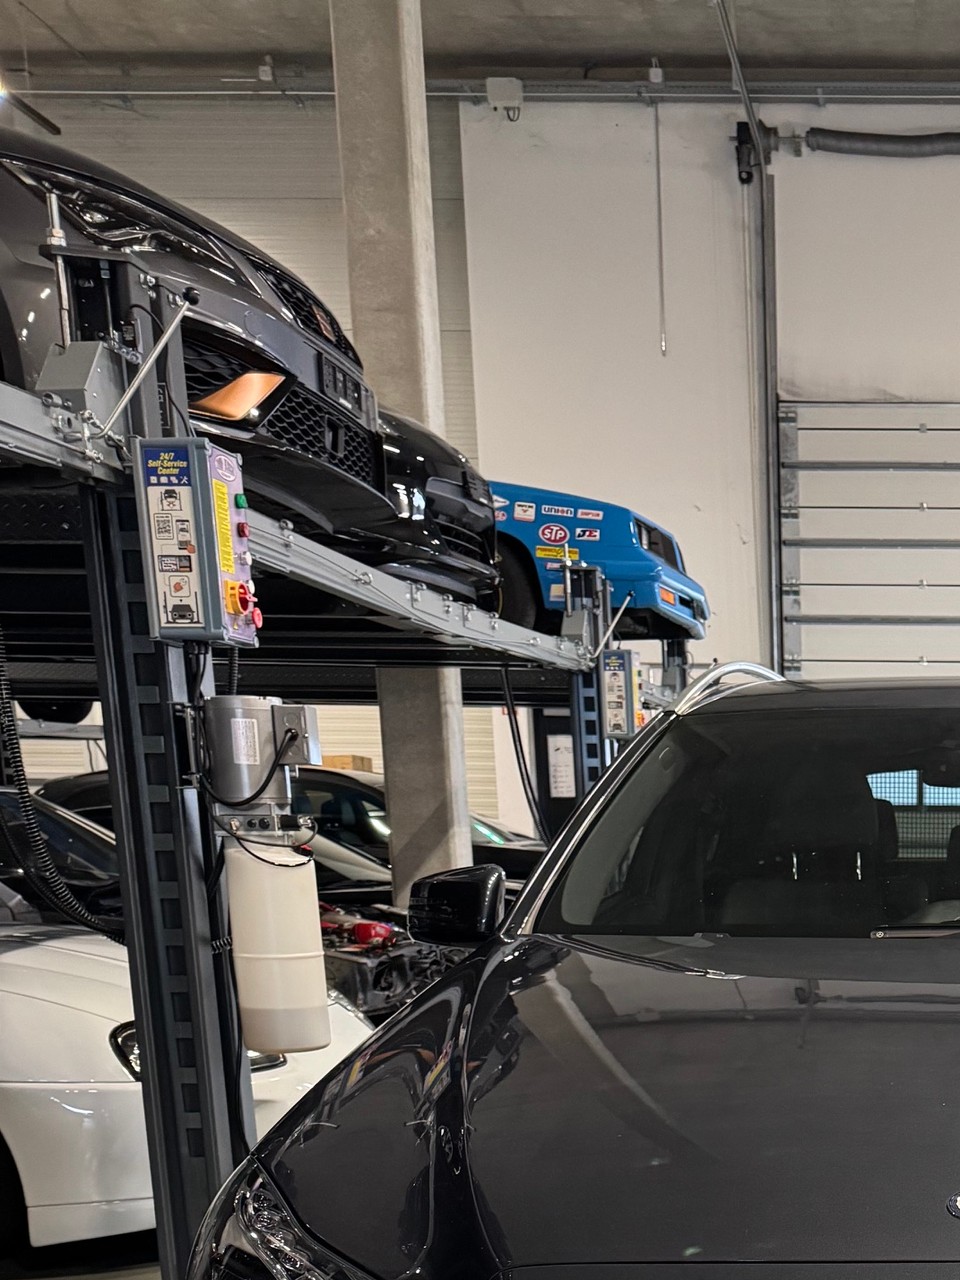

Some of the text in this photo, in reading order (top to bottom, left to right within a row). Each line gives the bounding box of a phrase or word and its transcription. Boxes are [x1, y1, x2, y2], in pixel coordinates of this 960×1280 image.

[147, 460, 188, 468] Self-Service
[158, 467, 180, 475] Center
[544, 526, 565, 540] STP
[577, 529, 598, 538] JE
